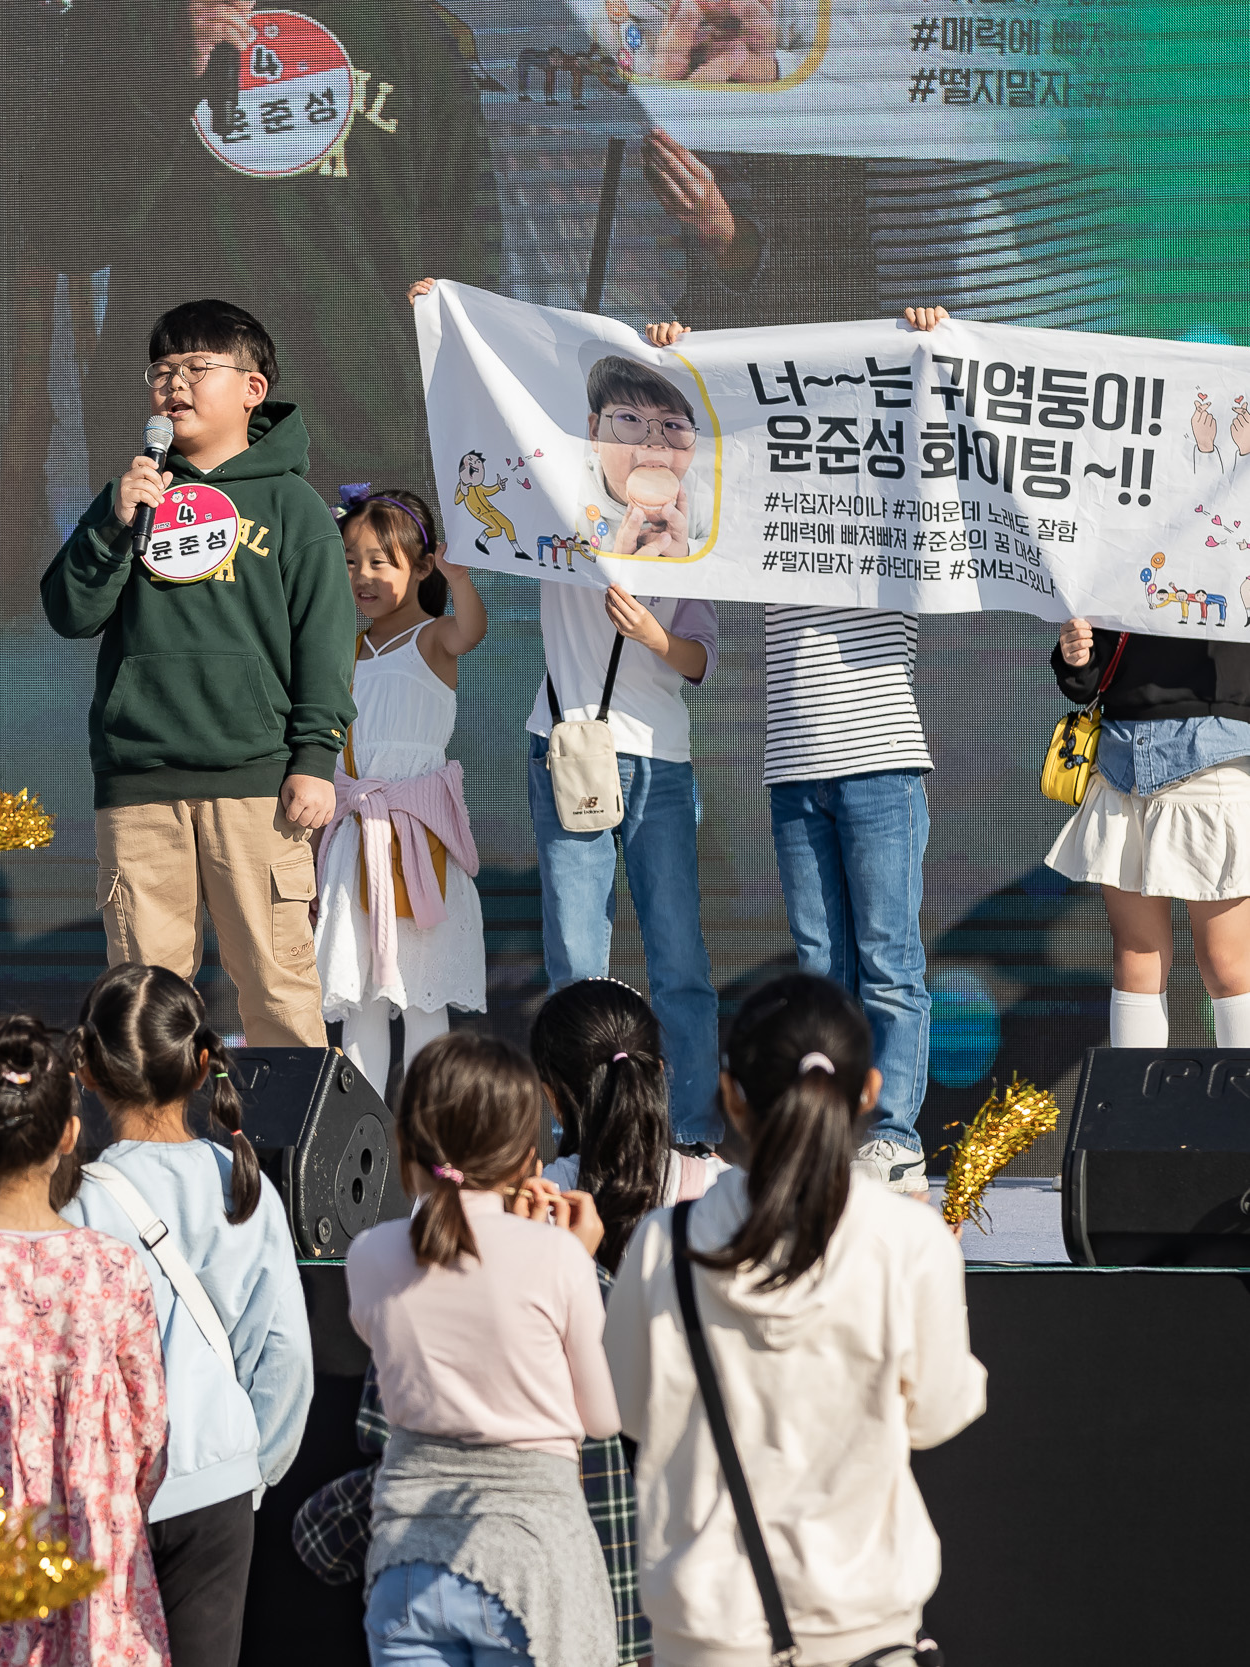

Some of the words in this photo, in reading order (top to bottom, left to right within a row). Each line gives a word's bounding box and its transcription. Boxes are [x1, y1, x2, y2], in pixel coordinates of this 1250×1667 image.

[908, 16, 1040, 55] #매력에
[254, 47, 279, 76] 4
[906, 67, 1071, 107] #떨지말자
[931, 353, 1166, 437] 귀염둥이!
[766, 414, 906, 480] 윤준성
[919, 421, 1073, 500] 화이팅
[178, 505, 195, 523] 4
[764, 492, 887, 518] #뉘집자식이냐
[893, 500, 980, 523] #귀여운데
[988, 502, 1030, 536] 노래도
[1037, 518, 1078, 543] 잘함
[151, 529, 227, 562] 윤준성
[763, 521, 835, 544] #매력에
[840, 524, 906, 550] 빠져빠져
[913, 529, 987, 552] #준성의
[994, 531, 1010, 554] 꿈
[1014, 538, 1042, 567] 대상
[762, 551, 854, 574] #떨지말자
[859, 555, 942, 581] #하던대로
[949, 558, 1056, 598] #SM보고있나
